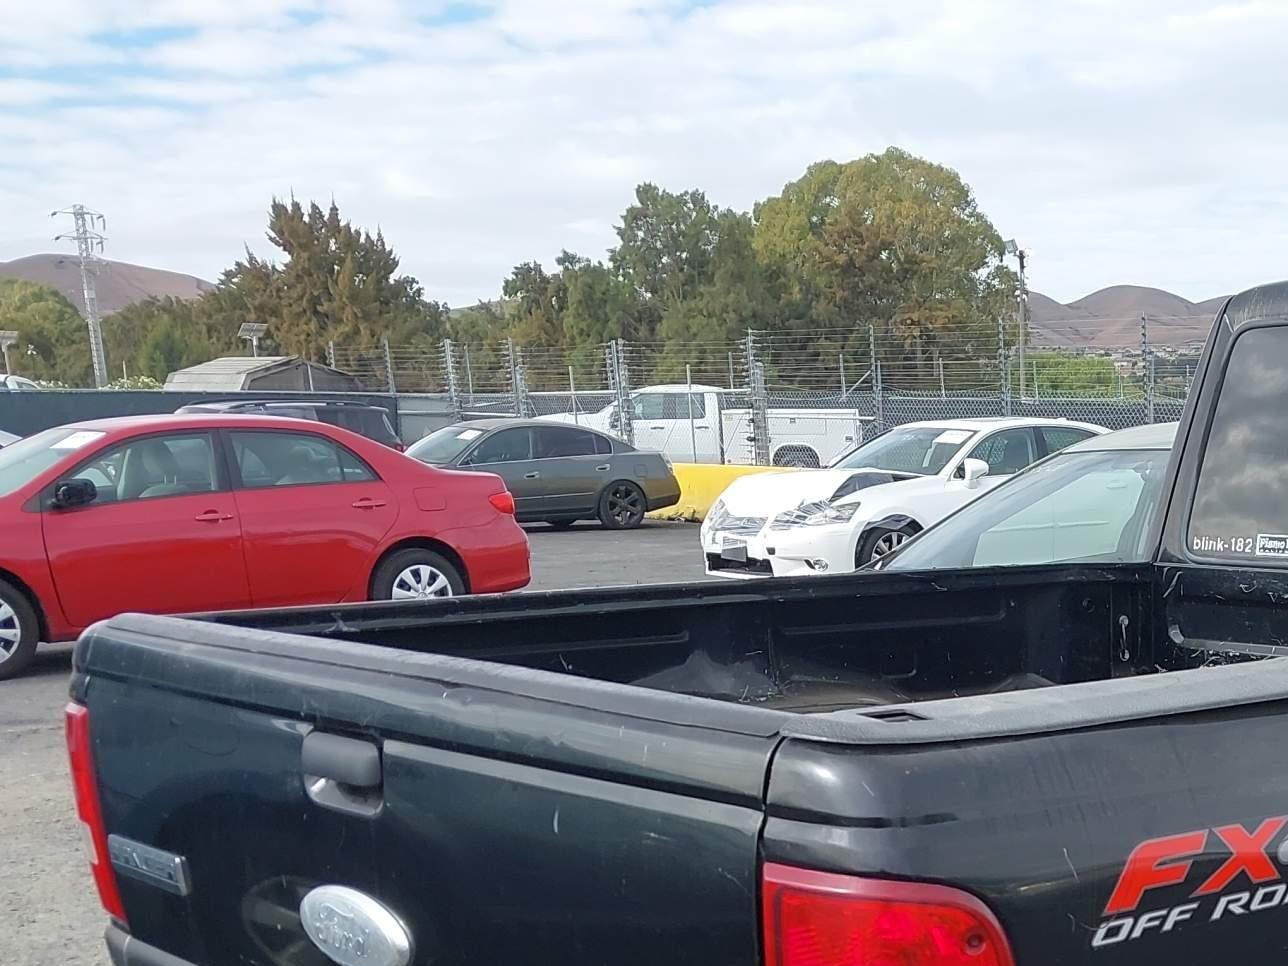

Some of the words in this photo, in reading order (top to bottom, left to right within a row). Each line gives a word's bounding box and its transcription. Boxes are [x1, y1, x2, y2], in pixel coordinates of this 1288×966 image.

[1193, 536, 1253, 553] blink-182
[314, 902, 373, 960] Ford
[1091, 901, 1200, 948] OFF
